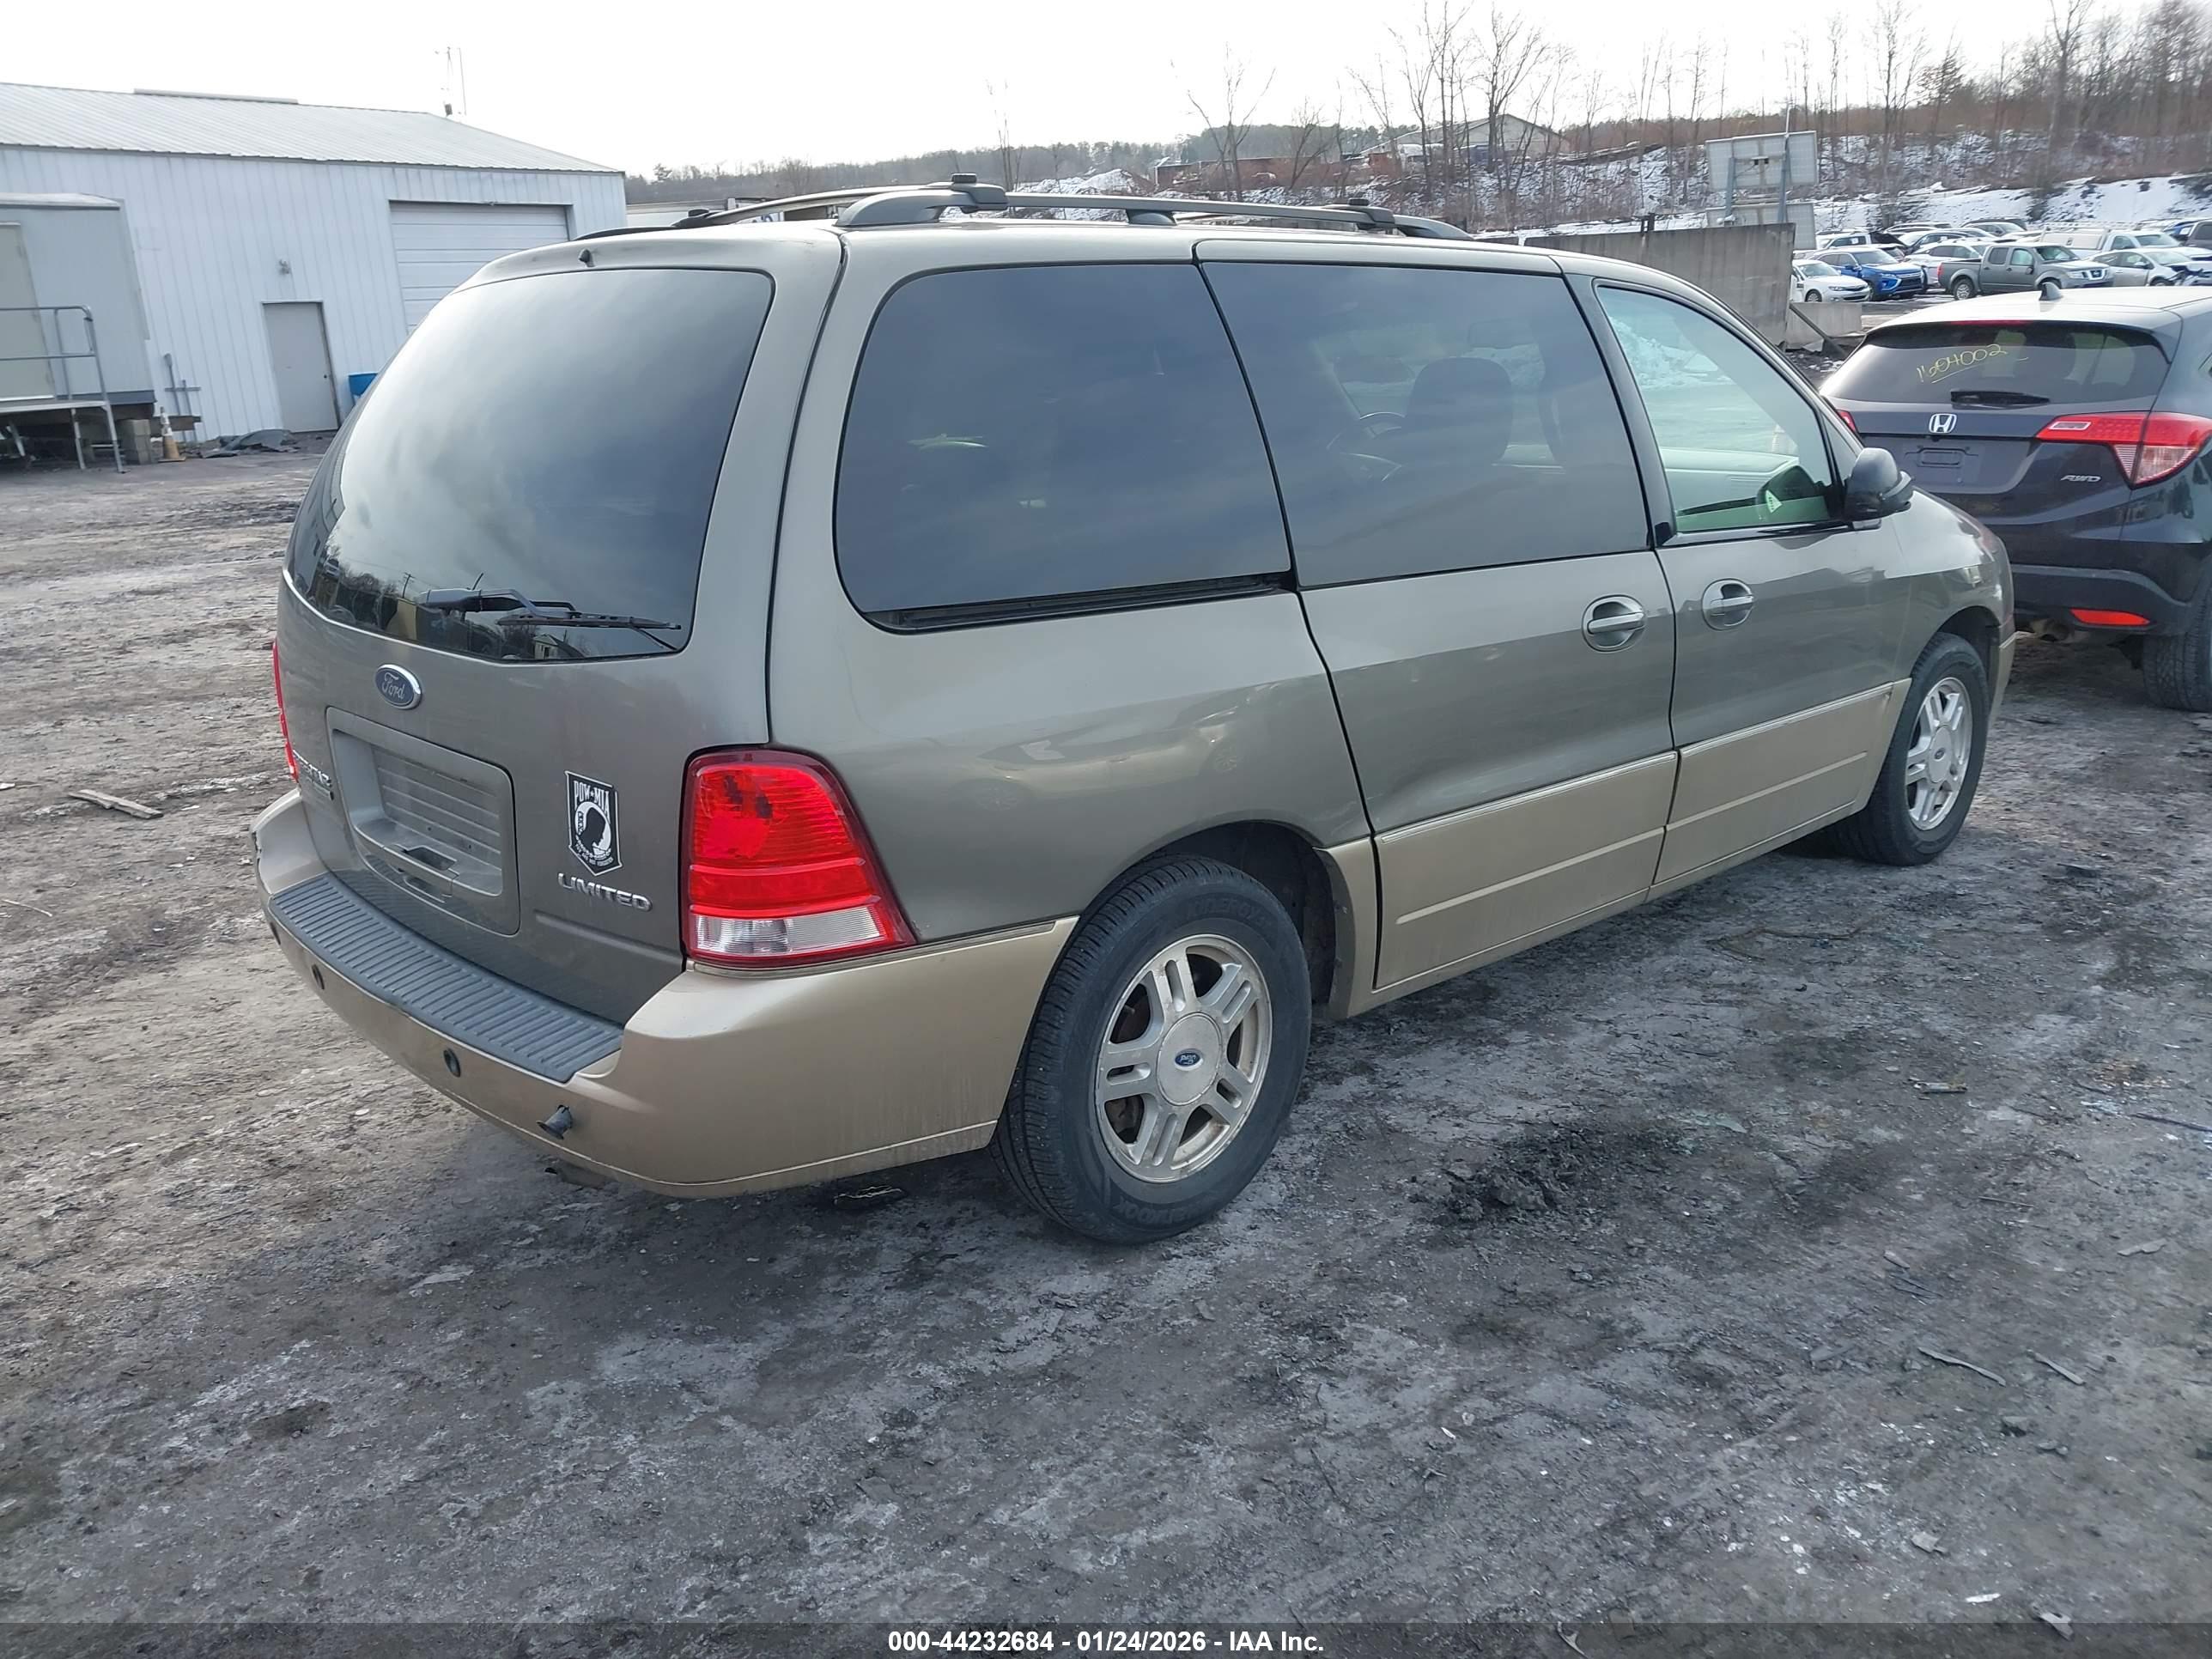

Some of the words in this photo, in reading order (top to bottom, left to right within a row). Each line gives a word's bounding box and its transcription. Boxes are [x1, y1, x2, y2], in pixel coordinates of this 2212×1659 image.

[2060, 474, 2102, 483] AWD
[574, 780, 591, 811] POW
[593, 787, 611, 825] MIA
[557, 872, 653, 912] LIMITED
